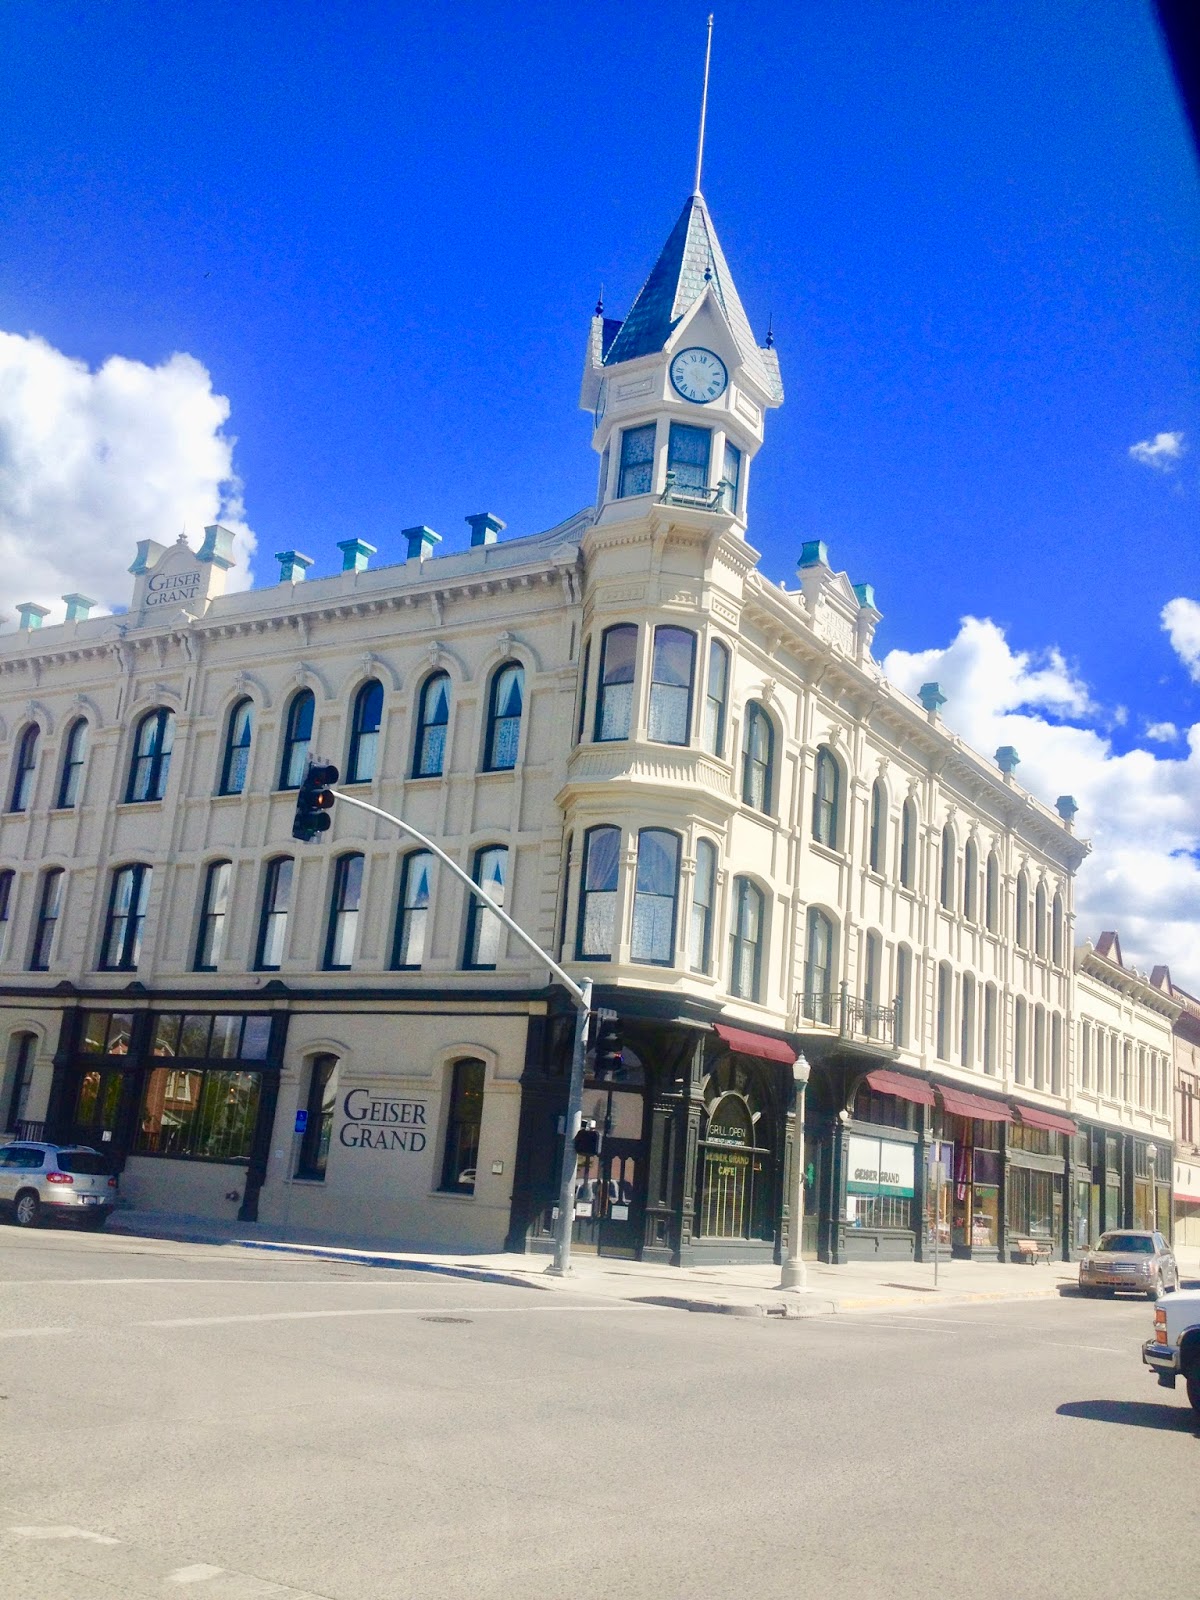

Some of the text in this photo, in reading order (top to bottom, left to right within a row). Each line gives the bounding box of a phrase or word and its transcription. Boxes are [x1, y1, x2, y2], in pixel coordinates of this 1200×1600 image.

[148, 573, 200, 591] GEISER
[343, 1088, 427, 1125] GEISER
[339, 1122, 426, 1152] GRAND
[709, 1124, 746, 1138] GRILL OPEN
[718, 1166, 735, 1176] CAFE
[854, 1168, 900, 1184] GEISER GRAND
